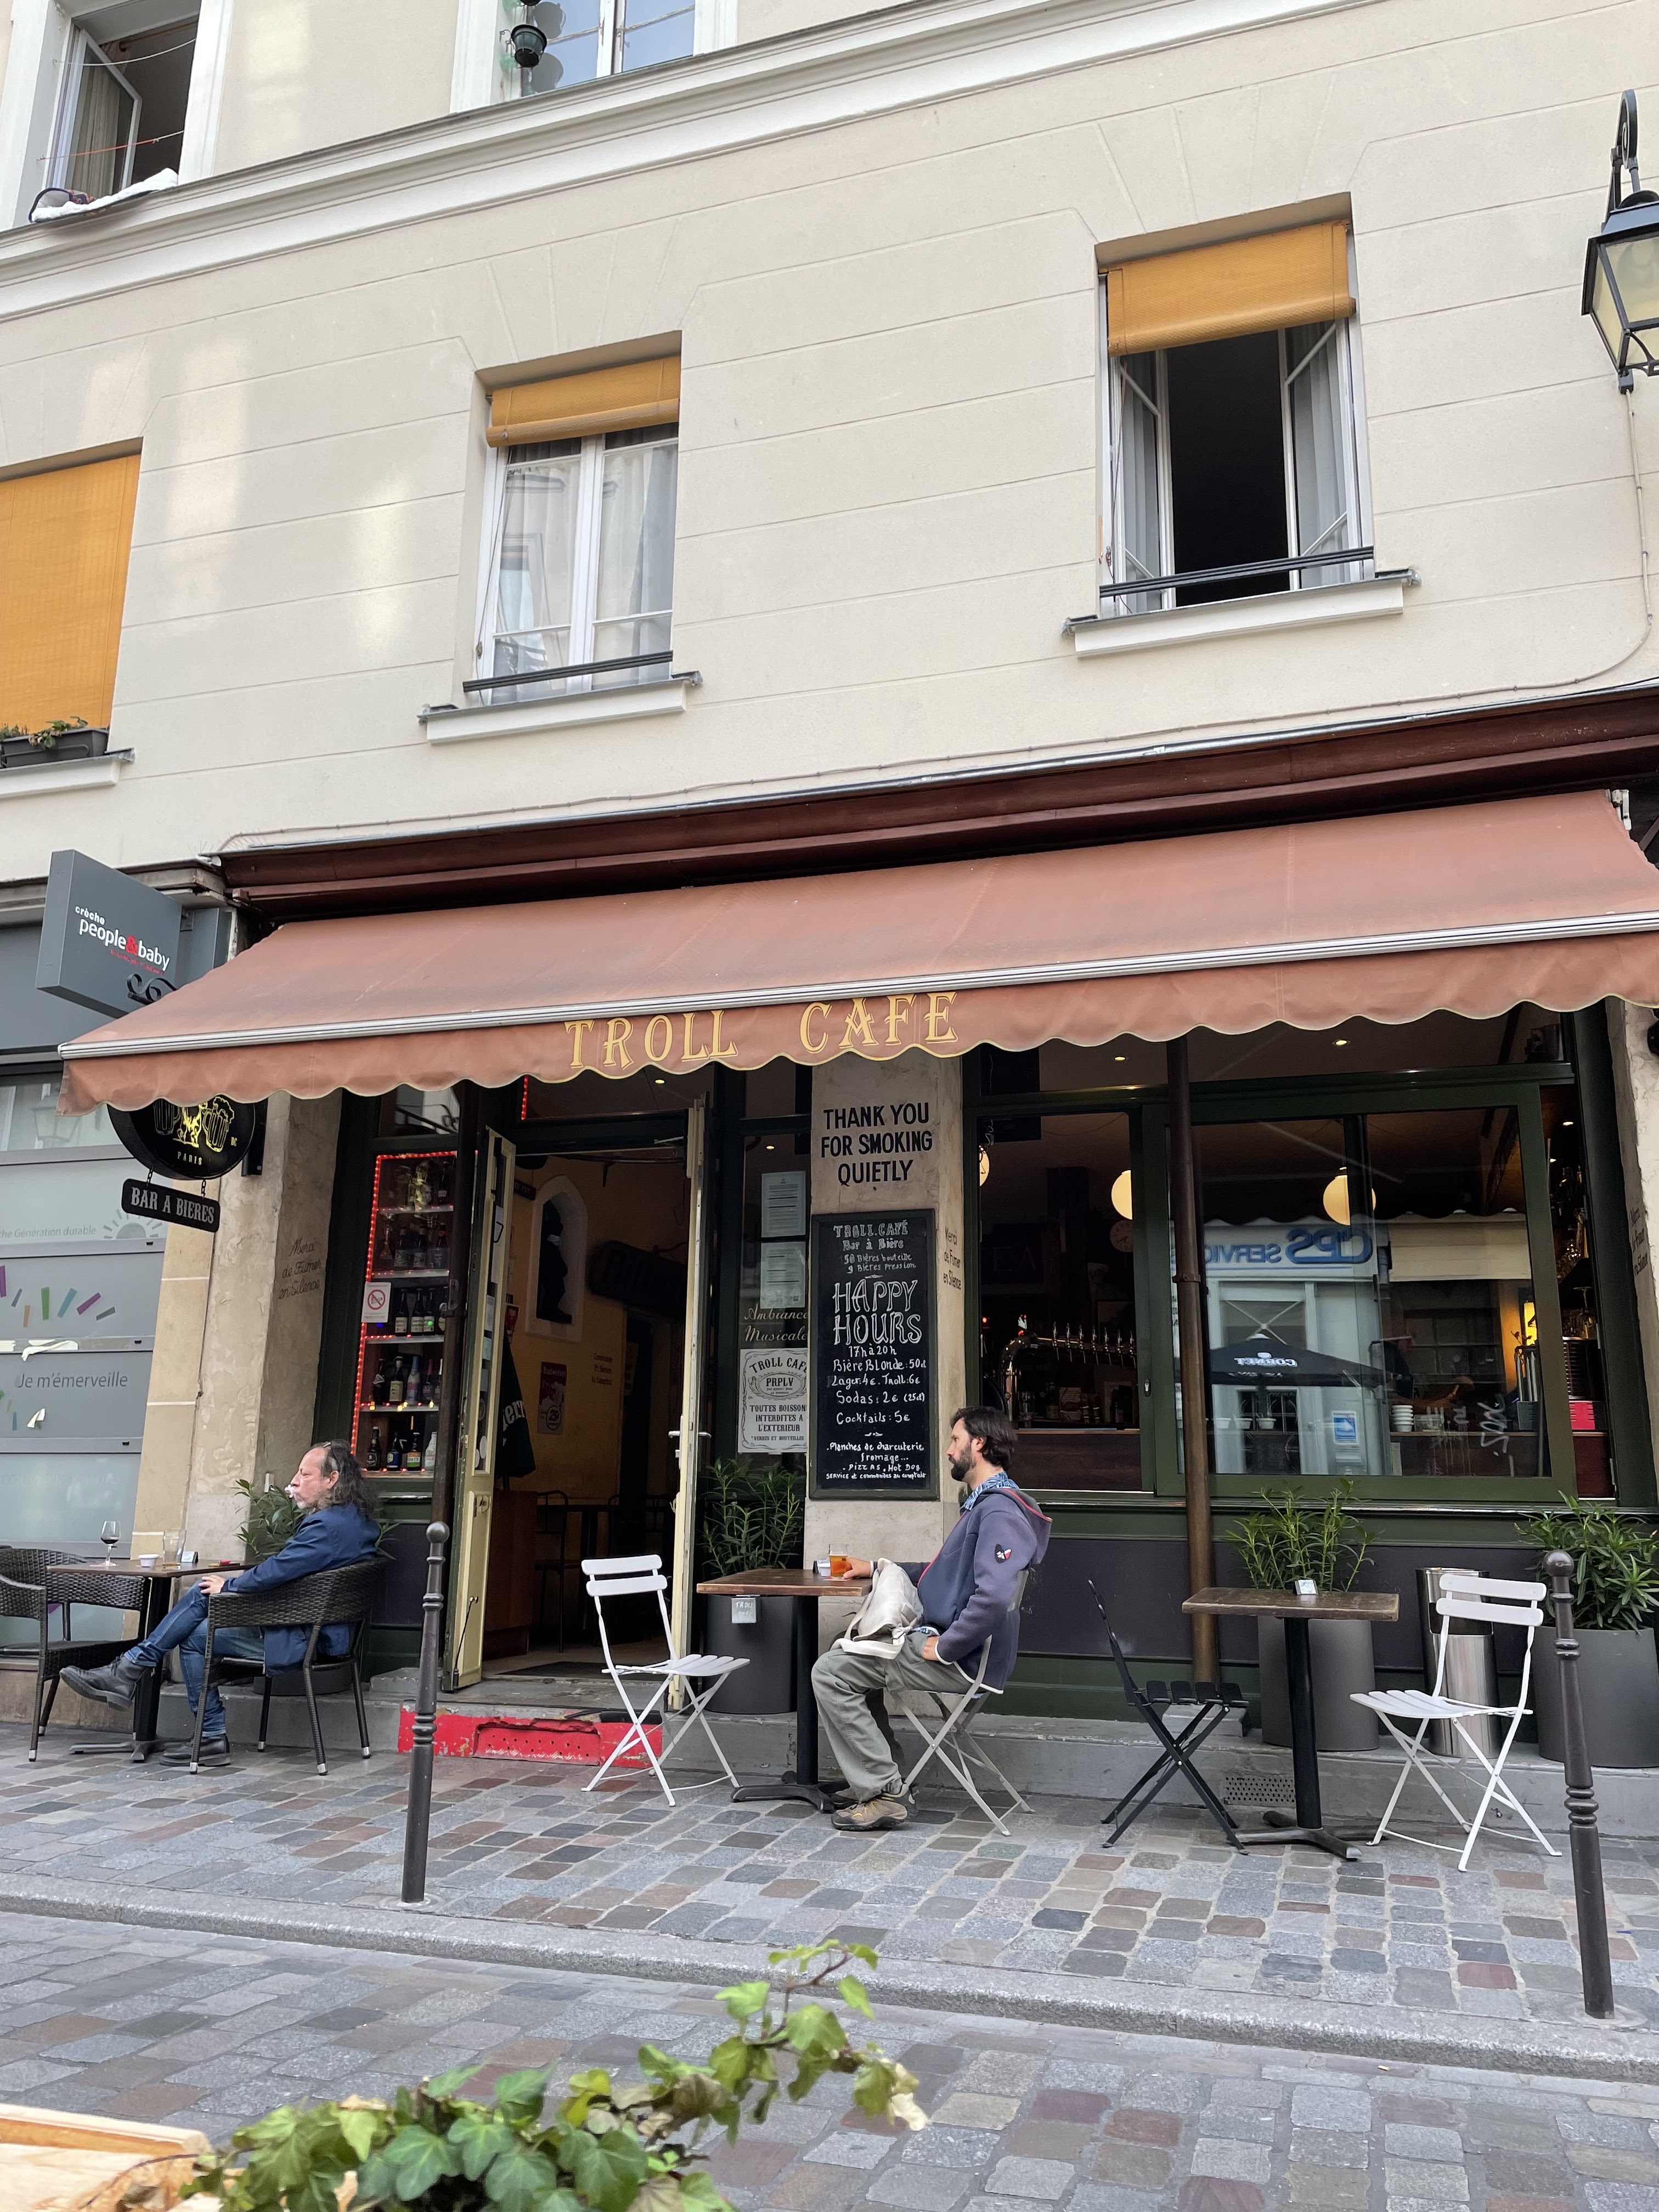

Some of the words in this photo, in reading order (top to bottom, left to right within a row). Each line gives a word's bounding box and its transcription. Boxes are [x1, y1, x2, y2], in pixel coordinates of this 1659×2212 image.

[565, 1009, 739, 1070] TROLL
[799, 991, 958, 1054] CAFE
[823, 1105, 885, 1130] THANK
[890, 1102, 929, 1125] YOU
[821, 1135, 853, 1158] FOR
[859, 1130, 933, 1155] SMOKING
[177, 1151, 202, 1166] PARIS
[838, 1159, 913, 1187] QUIETLY
[131, 1187, 158, 1210] BAR
[162, 1195, 172, 1214] A
[176, 1197, 215, 1224] BIERES
[14, 1226, 61, 1238] Génération
[63, 1224, 97, 1236] durable
[843, 1239, 860, 1251] Bar
[866, 1238, 873, 1250] à
[857, 1253, 879, 1262] Bières
[847, 1265, 854, 1274] 9
[857, 1261, 881, 1272] Bières
[832, 1278, 918, 1313] HAPPY
[744, 1303, 809, 1320] Ambiance
[744, 1325, 808, 1342] Musicale
[833, 1311, 922, 1345] HOURS
[749, 1357, 783, 1374] TROLL
[833, 1358, 863, 1372] Bière
[18, 1373, 33, 1389] Je
[37, 1372, 128, 1388] m'émerveille
[779, 1404, 808, 1412] BOISSON
[758, 1424, 800, 1432] L'EXTERIEUR
